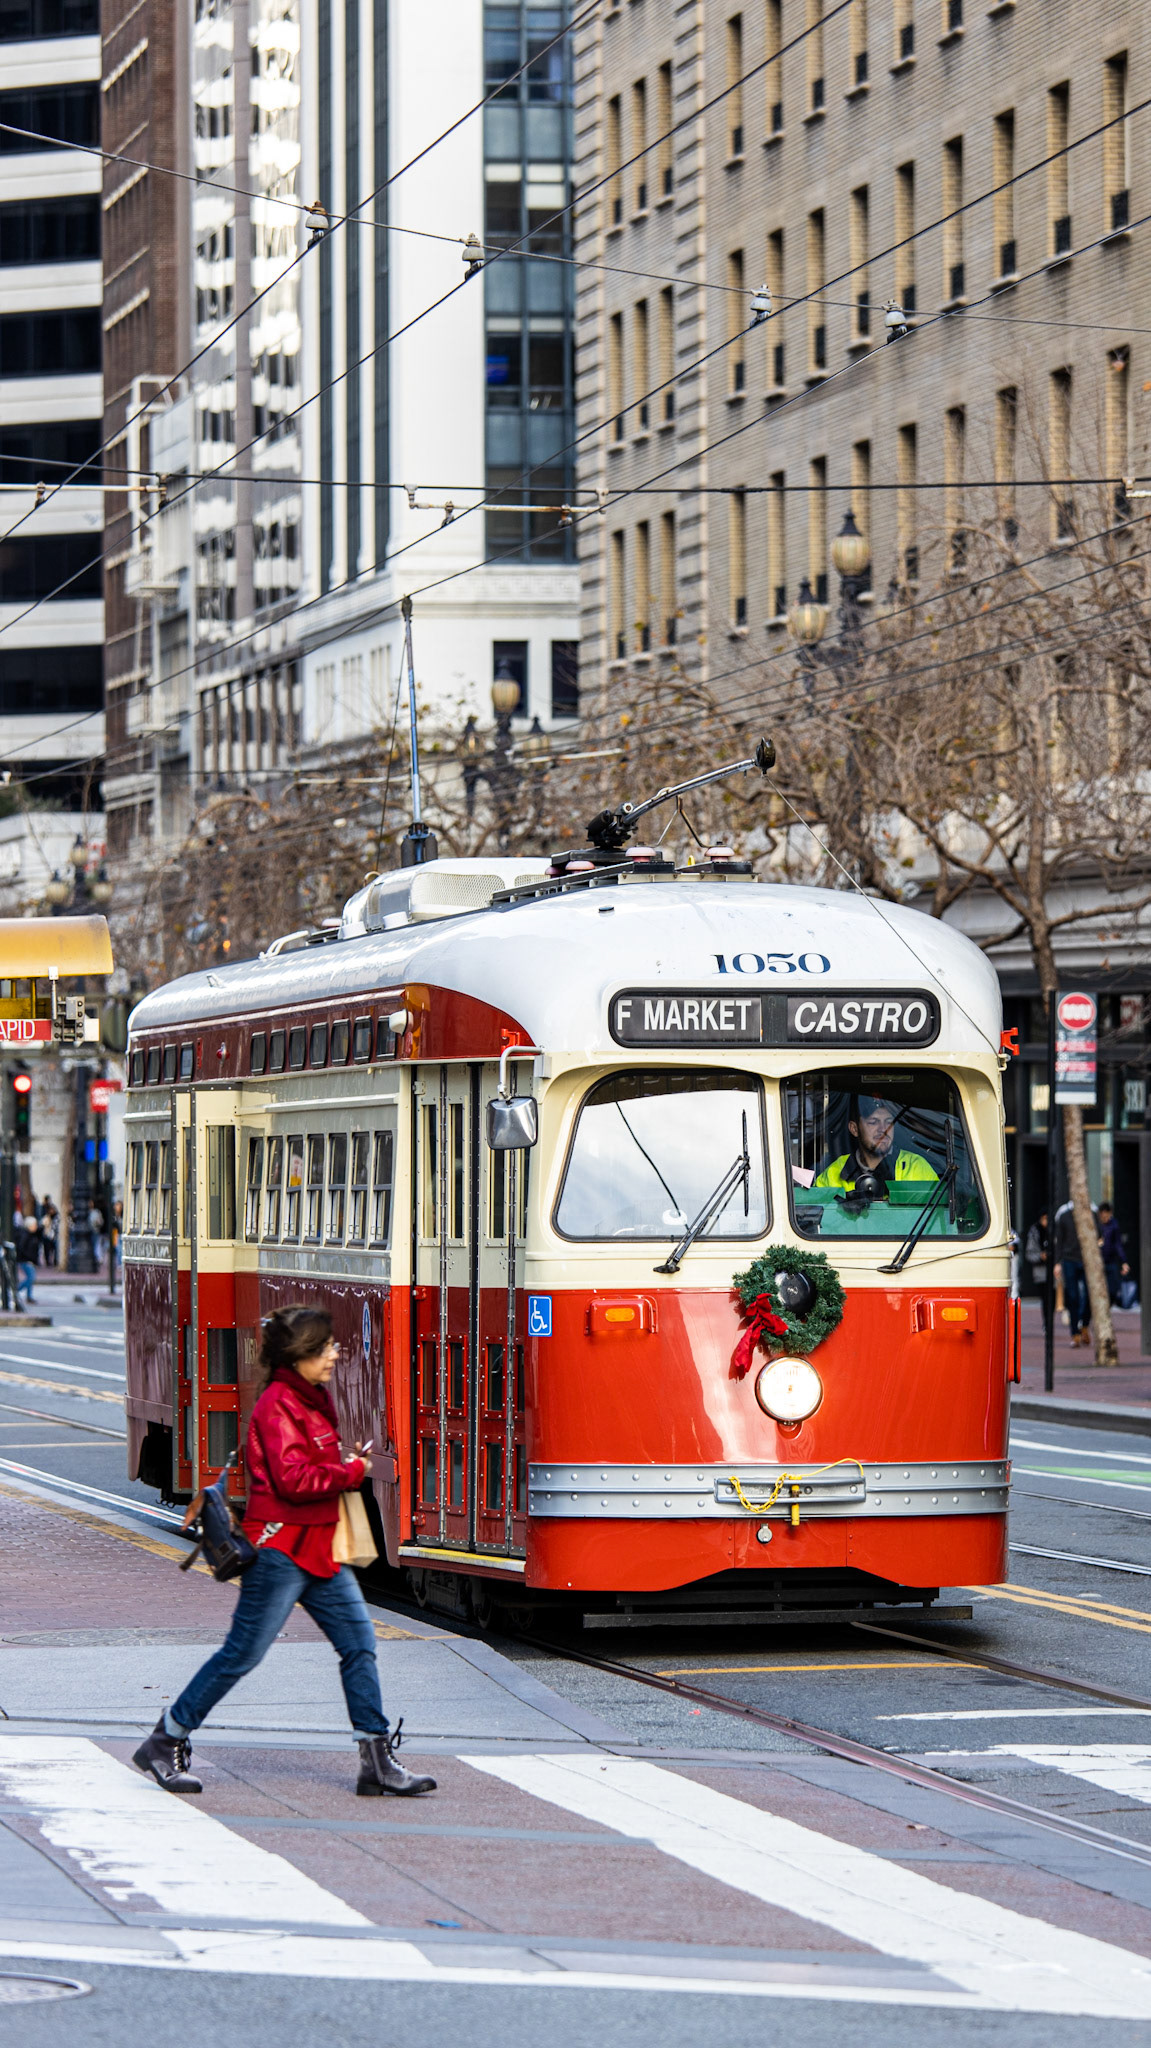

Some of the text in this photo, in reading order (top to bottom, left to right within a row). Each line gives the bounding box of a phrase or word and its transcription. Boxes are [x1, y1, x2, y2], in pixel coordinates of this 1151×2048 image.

[710, 952, 831, 974] 1050
[617, 1000, 928, 1034] F MARKET CASTRO
